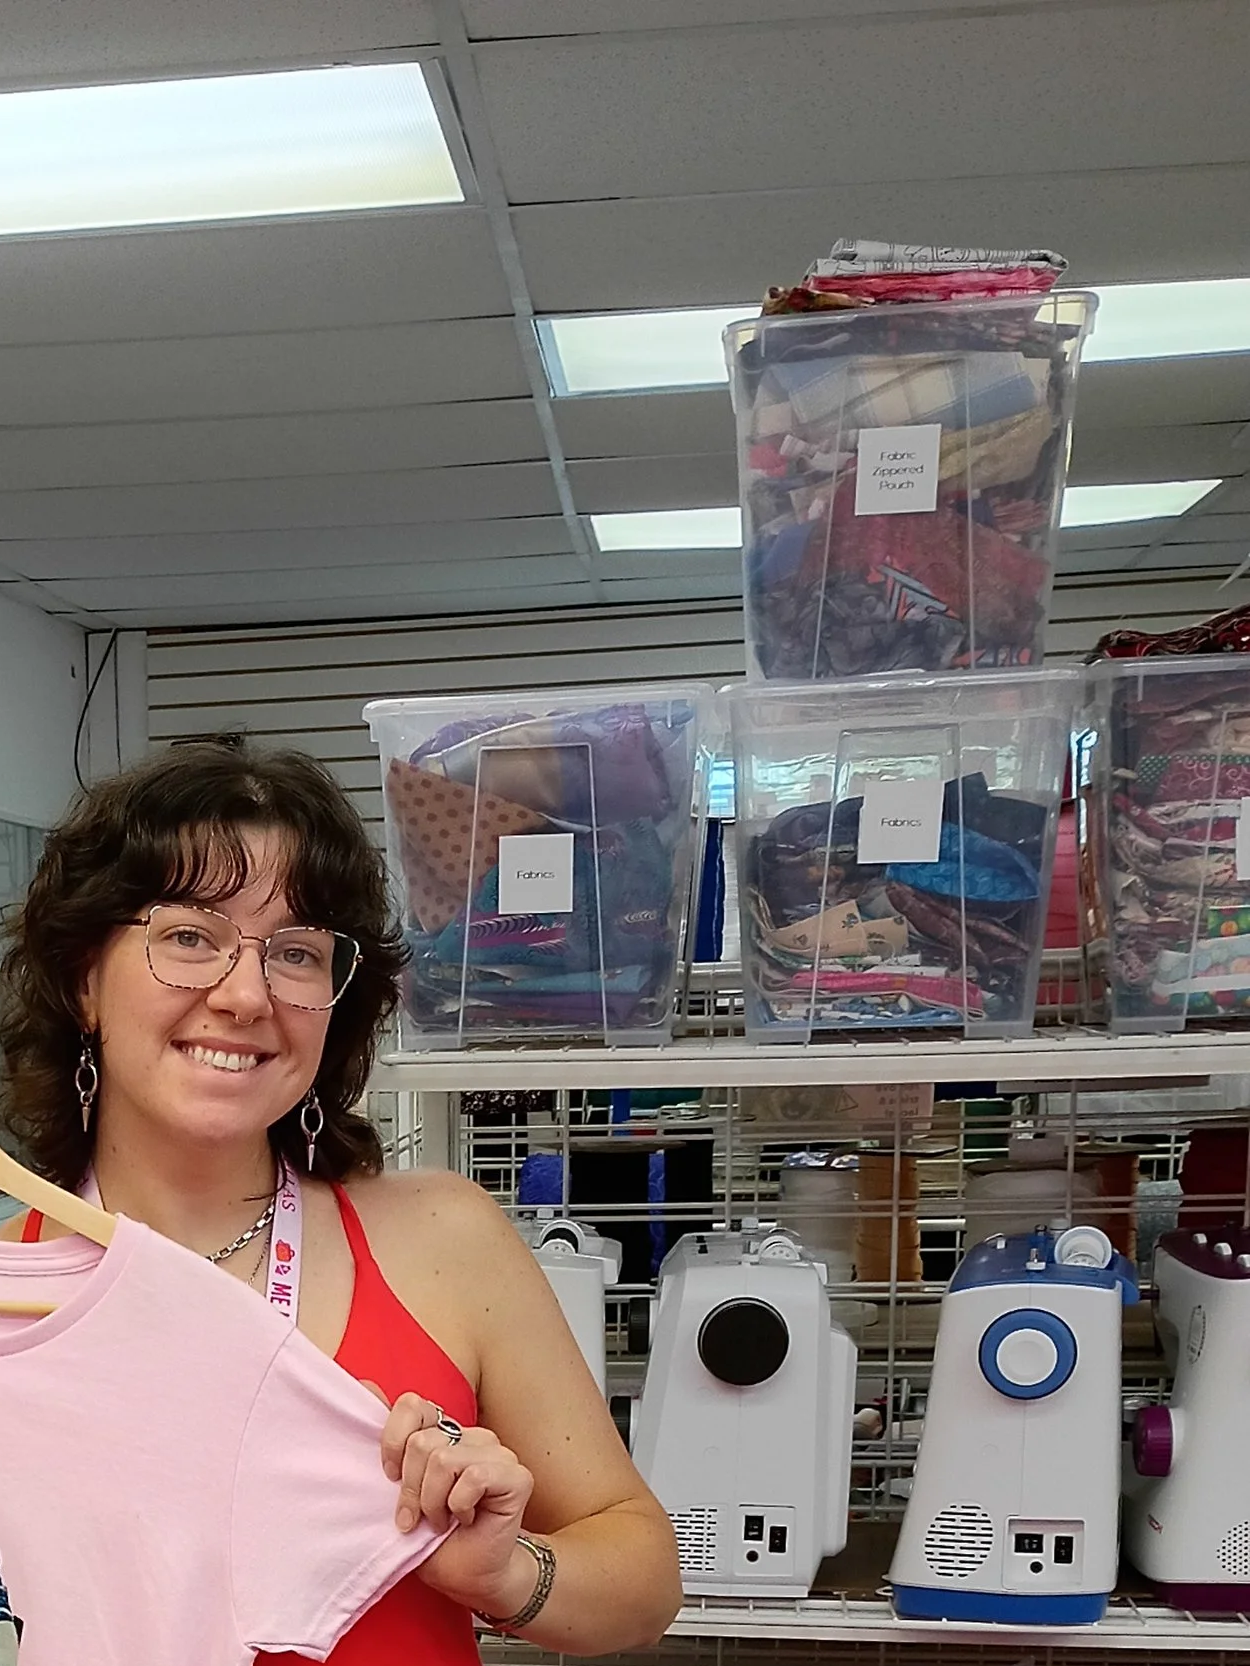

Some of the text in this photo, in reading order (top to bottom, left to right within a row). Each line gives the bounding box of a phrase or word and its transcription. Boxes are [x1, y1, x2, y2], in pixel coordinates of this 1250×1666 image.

[880, 451, 917, 462] Fabric
[872, 464, 924, 477] Zippered
[879, 480, 915, 490] Pouch
[881, 817, 922, 827] Fabrics
[516, 870, 555, 880] Fabrics
